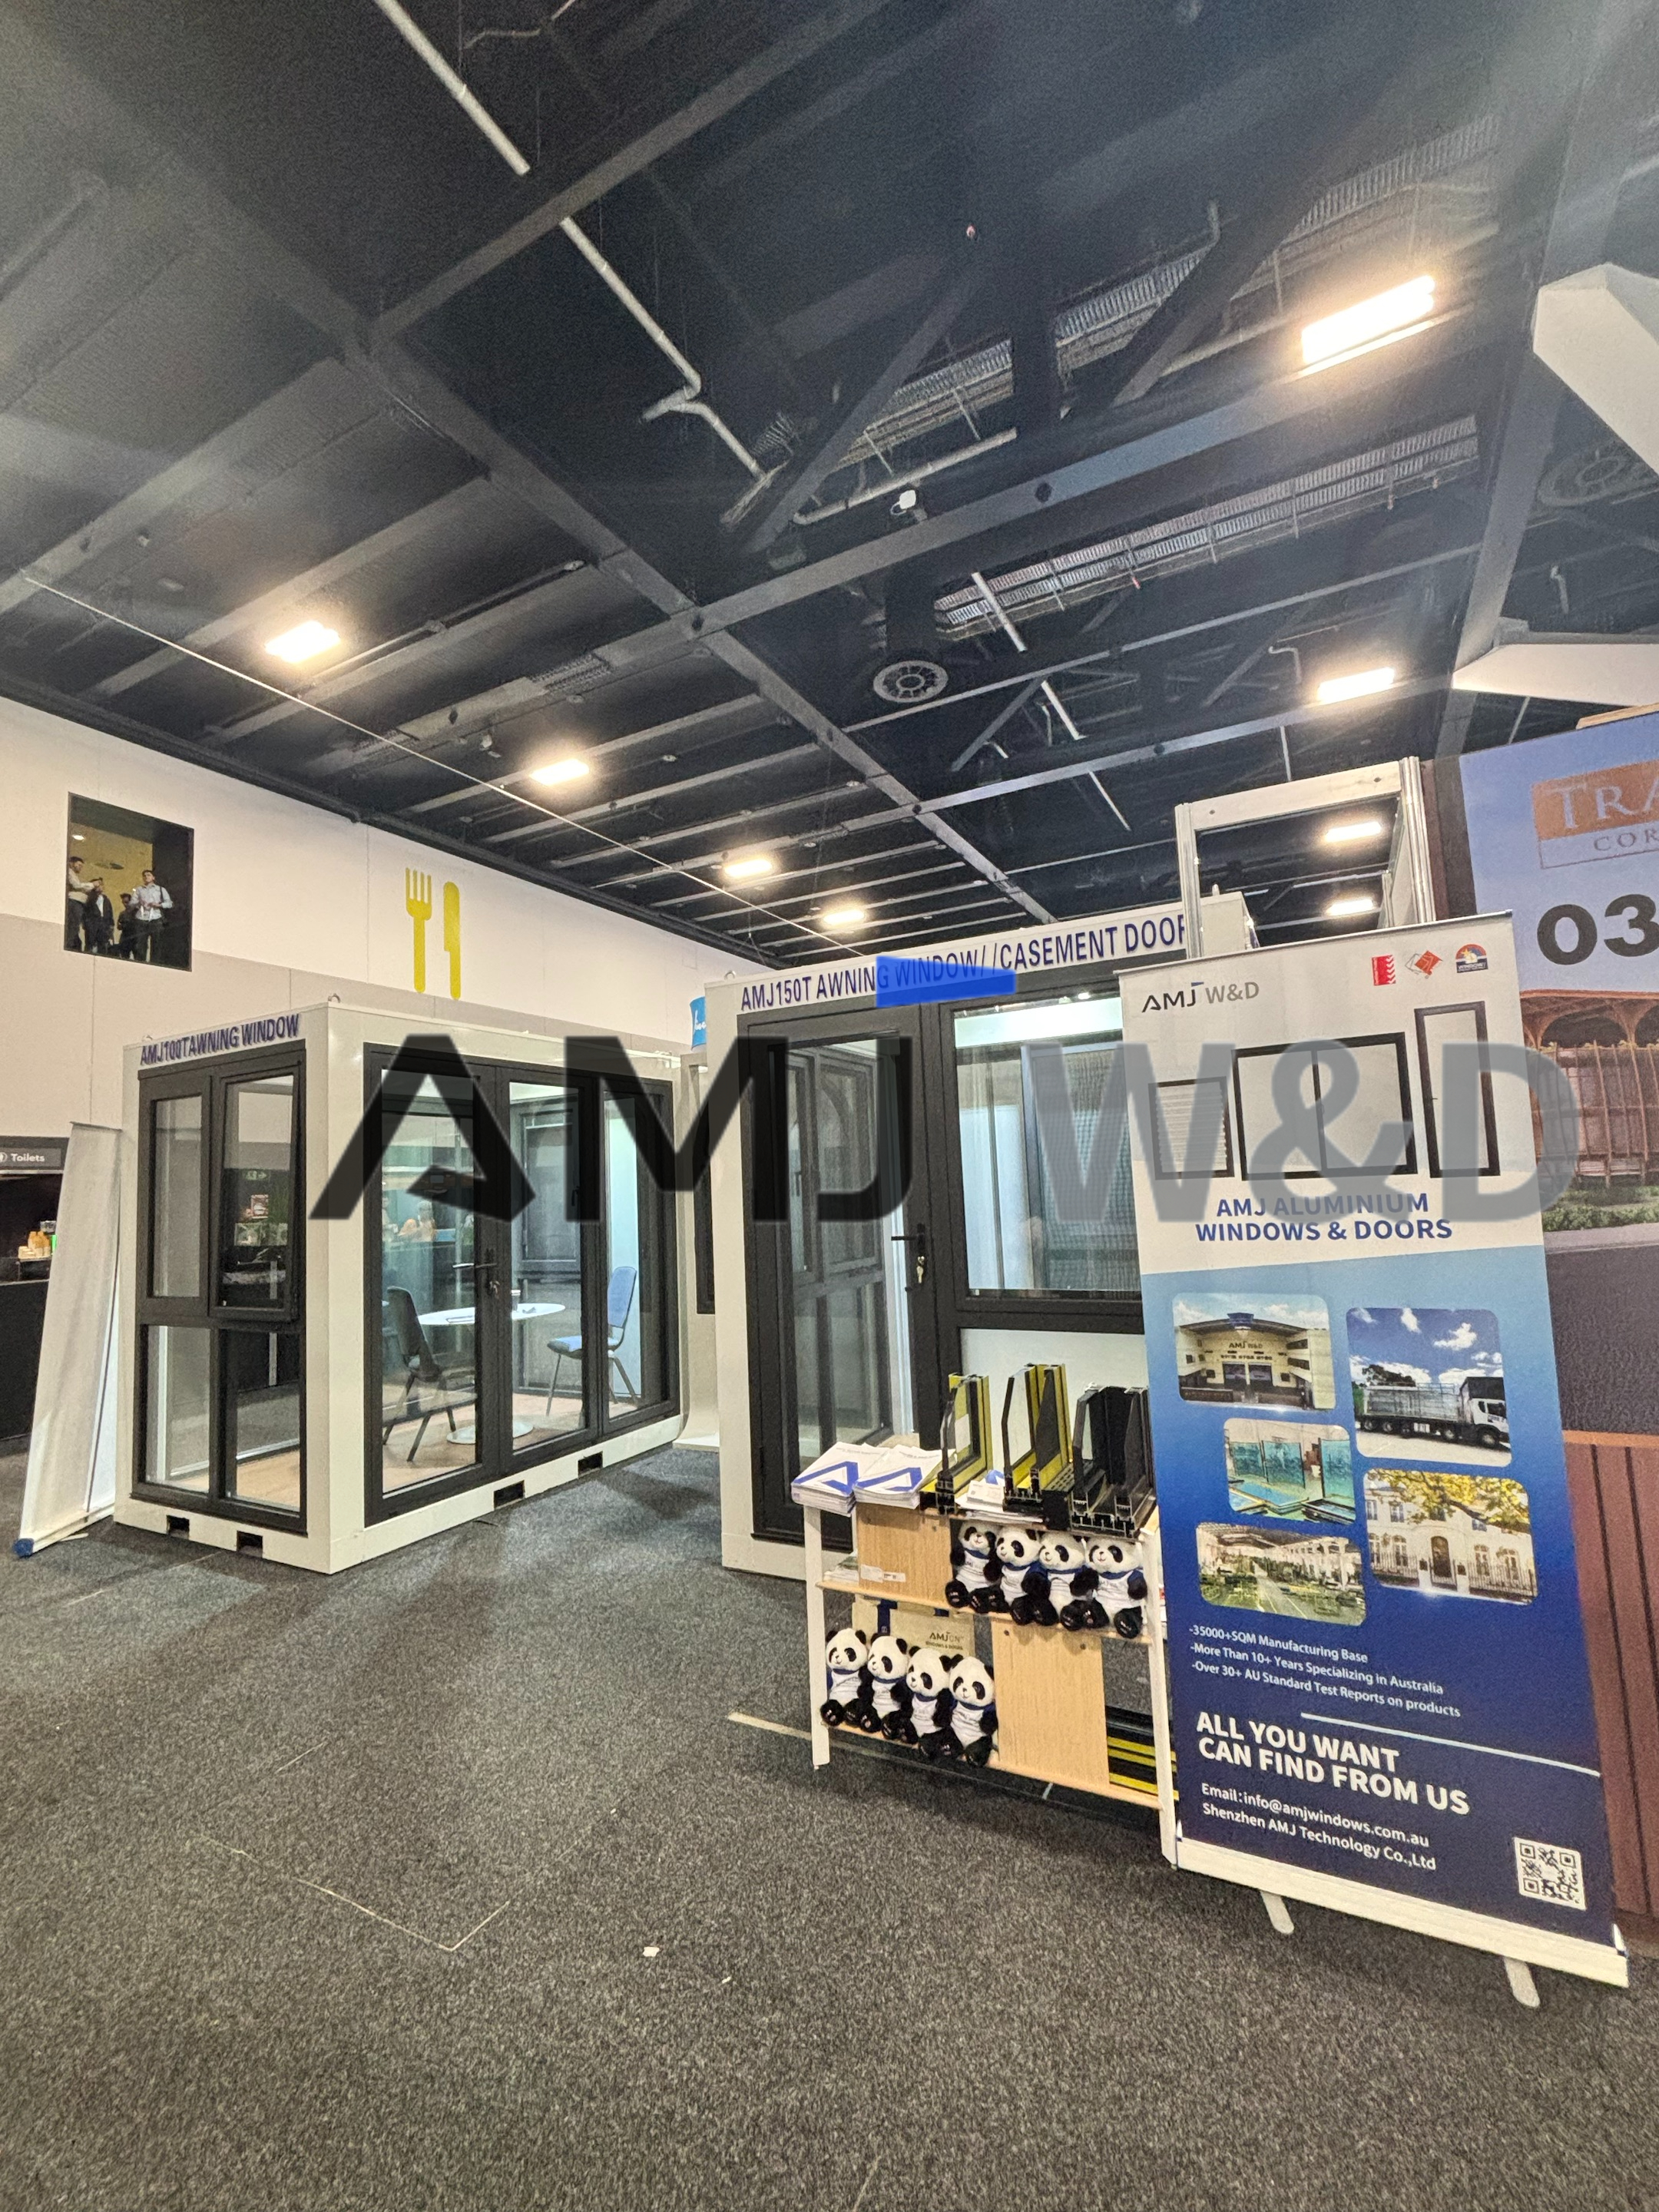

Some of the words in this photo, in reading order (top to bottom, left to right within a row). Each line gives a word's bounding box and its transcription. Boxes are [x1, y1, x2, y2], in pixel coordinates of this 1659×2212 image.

[1537, 894, 1659, 965] 03
[741, 976, 812, 1011] AMJ150T
[816, 964, 889, 998] AWNING
[1142, 982, 1204, 1012] AMJ
[1205, 982, 1260, 1005] W&D
[241, 1013, 300, 1046] WINDOW
[11, 1153, 45, 1162] Toilets
[1217, 1198, 1267, 1217] AMJ
[1274, 1192, 1429, 1216] ALUMINIUM
[1195, 1221, 1321, 1242] WINDOWS
[1327, 1220, 1347, 1240] &
[1354, 1218, 1452, 1240] DOORS
[1190, 1642, 1221, 1657] -More
[1223, 1647, 1249, 1661] Than
[1252, 1651, 1272, 1664] 10+
[1274, 1655, 1304, 1671] Years
[1306, 1662, 1373, 1685] Specializing
[1376, 1673, 1388, 1686] in
[1390, 1675, 1444, 1695] Australia
[1258, 1635, 1339, 1661] Manufacturing
[1341, 1648, 1369, 1663] Base
[1192, 1661, 1220, 1674] -Over
[1222, 1664, 1242, 1677] 30+
[1245, 1668, 1260, 1681] AU
[1263, 1672, 1312, 1691] Standard
[1313, 1681, 1338, 1697] Test
[1340, 1686, 1386, 1705] Reports
[1387, 1697, 1403, 1707] on
[1406, 1699, 1461, 1718] products
[1196, 1711, 1245, 1741] ALL
[1248, 1720, 1306, 1753] YOU
[1312, 1734, 1399, 1773] WANT
[1198, 1737, 1252, 1768] CAN
[1258, 1748, 1325, 1784] FIND
[1331, 1764, 1419, 1805] FROM
[1426, 1783, 1471, 1816] US
[1203, 1803, 1266, 1830] Shenzhen
[1268, 1818, 1296, 1836] AMJ
[1300, 1825, 1381, 1859] Technology
[1383, 1846, 1437, 1871] Co.,Ltd
